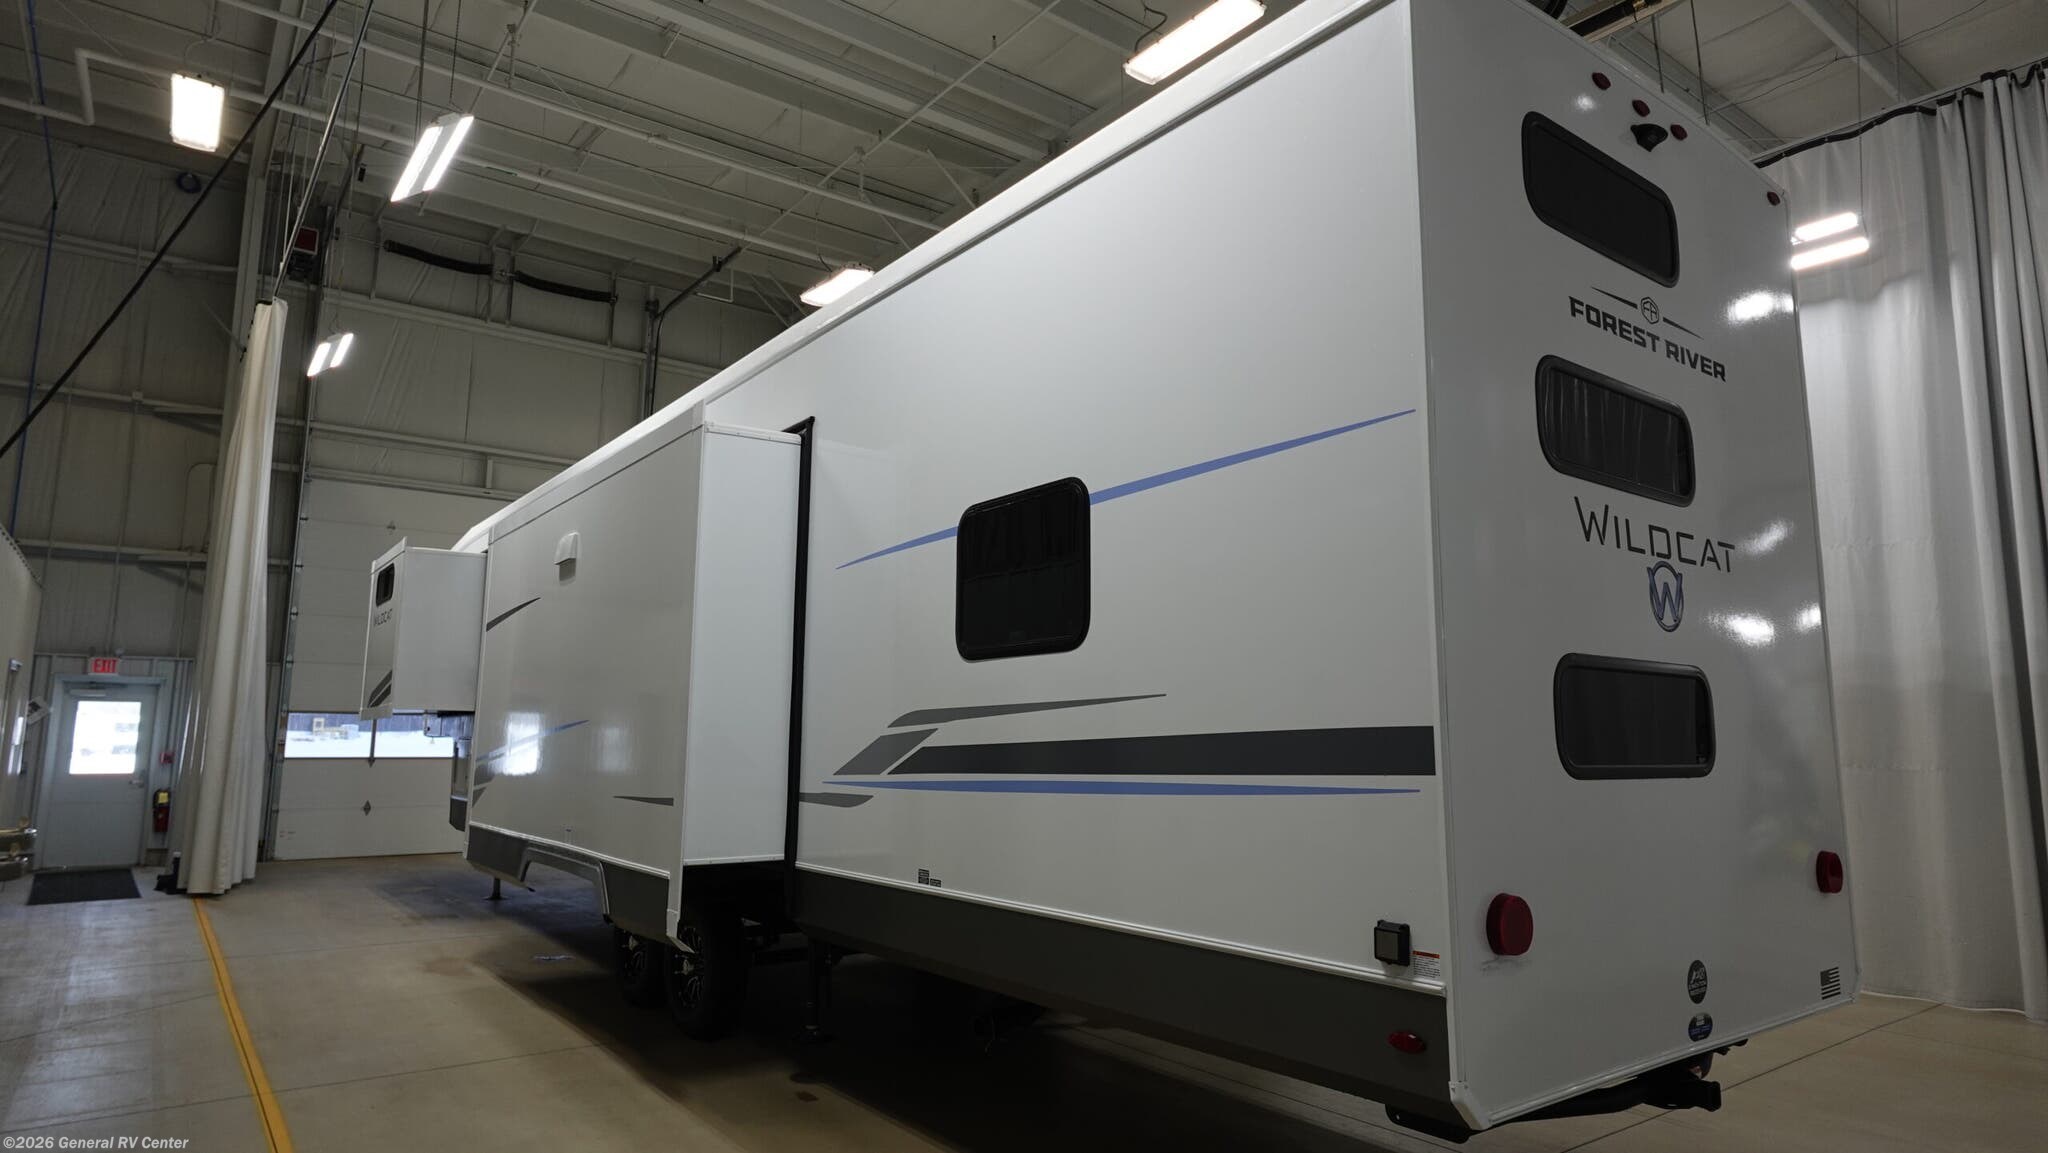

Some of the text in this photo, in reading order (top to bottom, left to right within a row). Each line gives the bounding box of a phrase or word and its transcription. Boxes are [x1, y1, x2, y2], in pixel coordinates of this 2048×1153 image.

[1568, 295, 1727, 383] FOREST RIVER
[1574, 496, 1736, 573] WILDCAT
[93, 658, 117, 673] EXIT
